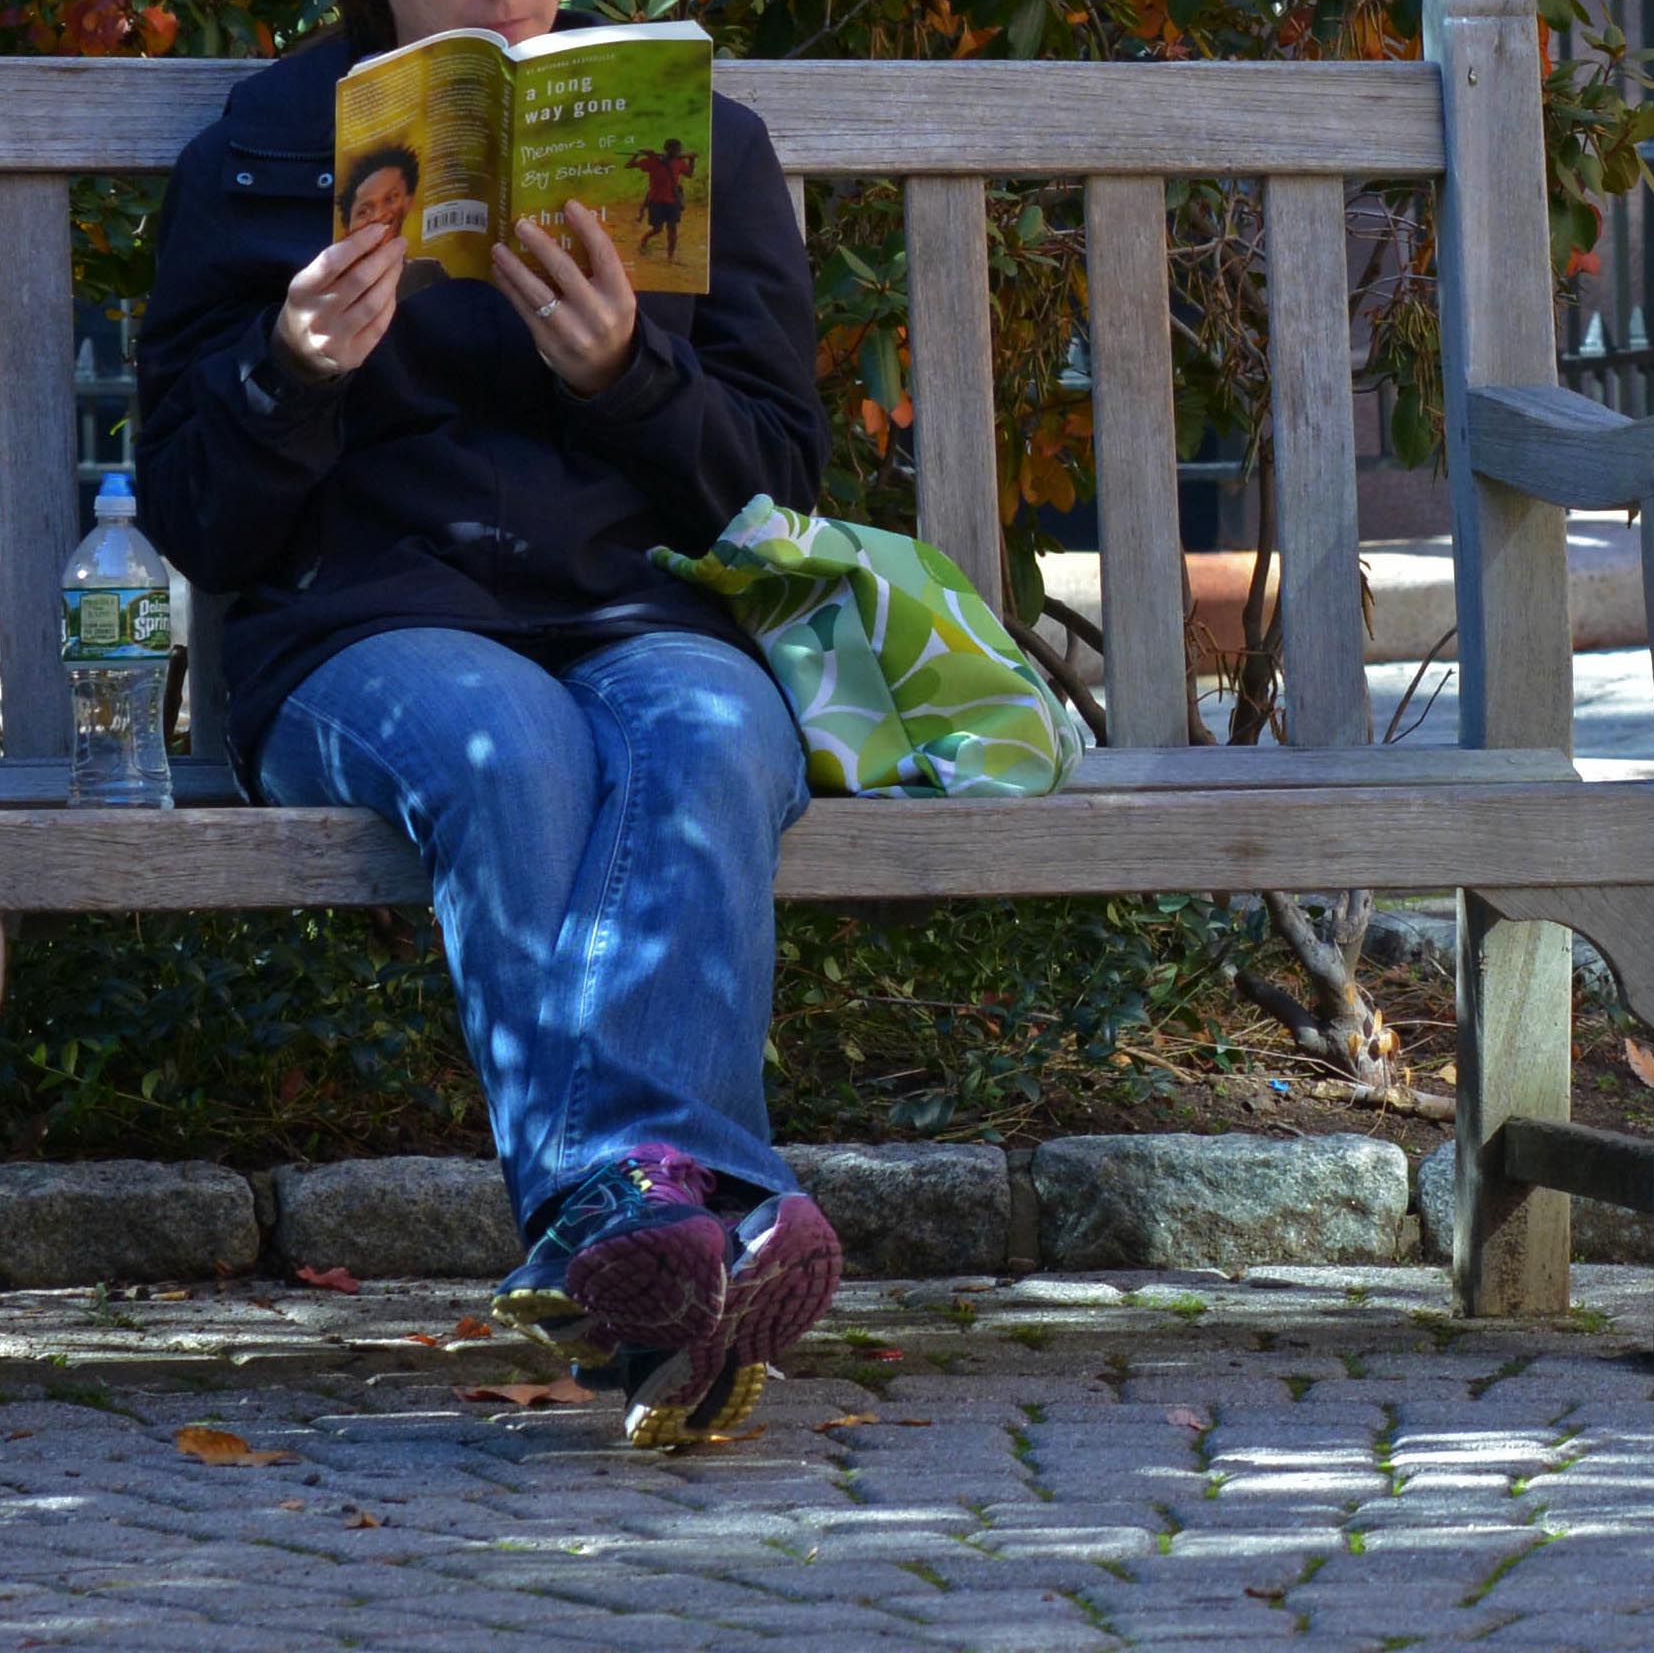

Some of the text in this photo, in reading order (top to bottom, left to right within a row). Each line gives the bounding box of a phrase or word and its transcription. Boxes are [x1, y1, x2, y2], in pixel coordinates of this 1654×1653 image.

[526, 77, 593, 101] a long
[525, 98, 627, 125] way gone
[521, 138, 586, 165] Memoirs
